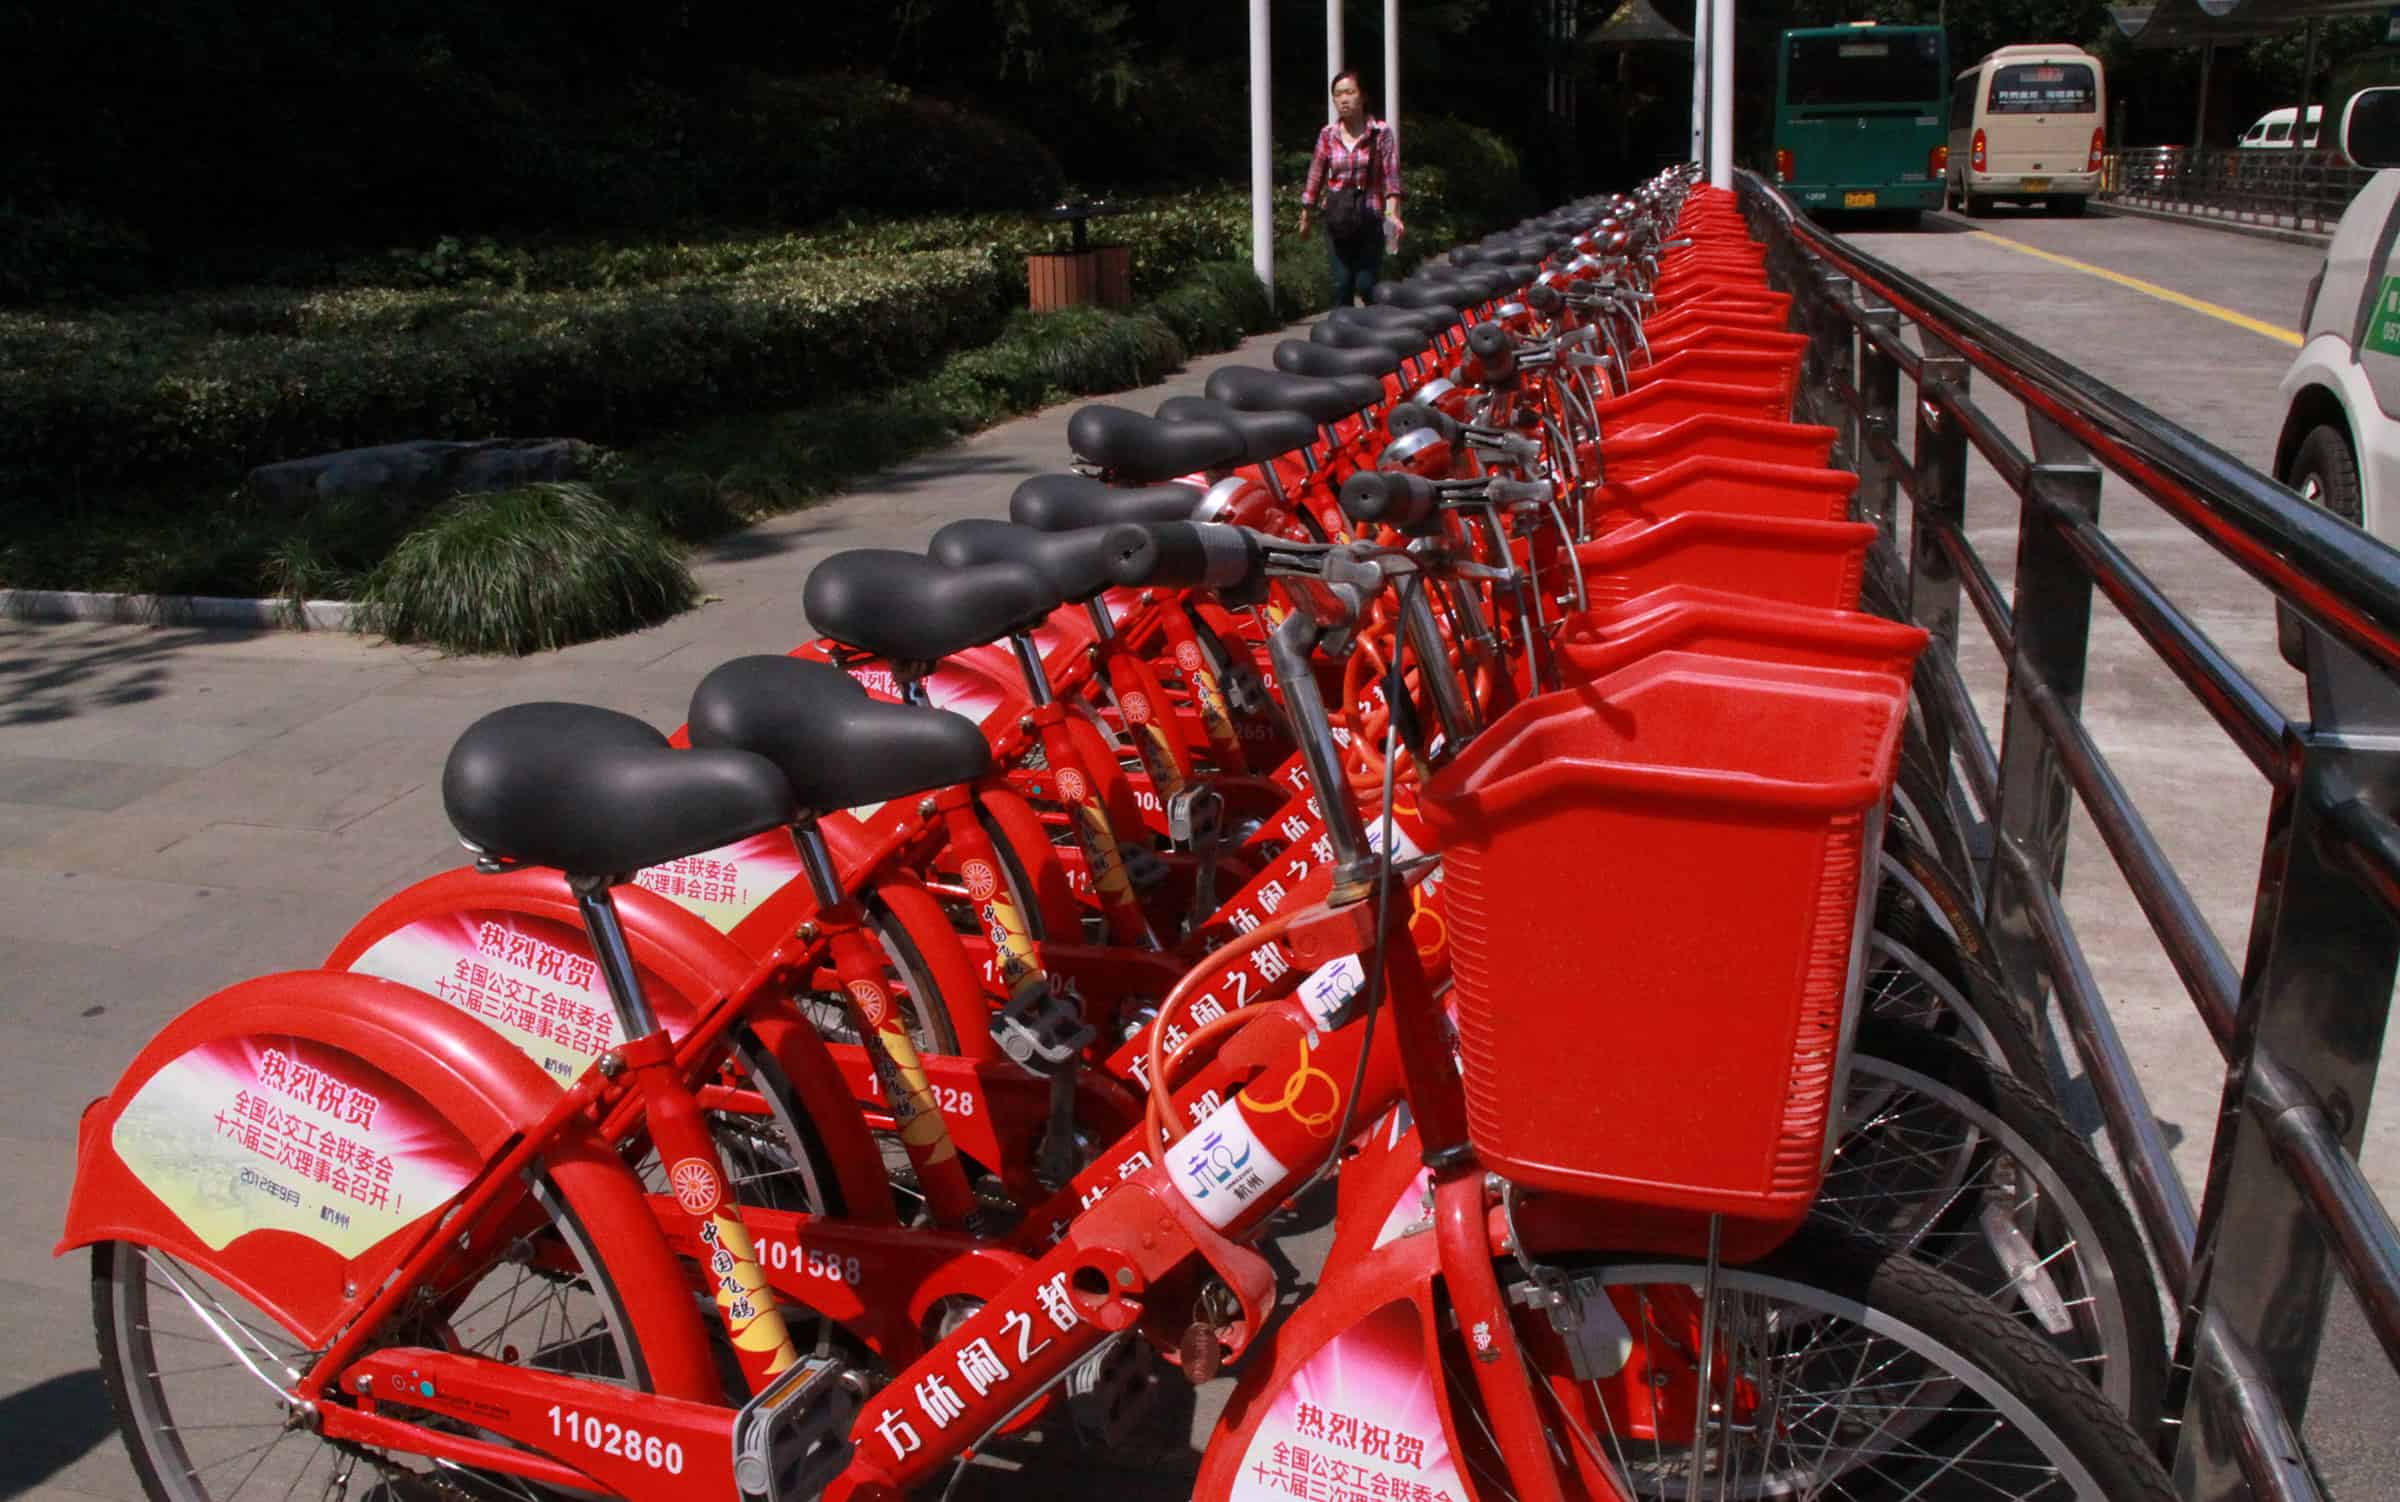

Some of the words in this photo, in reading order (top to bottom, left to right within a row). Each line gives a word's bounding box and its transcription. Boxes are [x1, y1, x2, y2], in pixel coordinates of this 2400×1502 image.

[480, 921, 598, 992] 热烈祝贺
[453, 957, 614, 1037] 全国公交工会联委会
[259, 1049, 379, 1132] 热烈祝贺
[214, 1109, 403, 1215] 十六届三次理事会召开！
[232, 1089, 395, 1184] 全国公交工会联委会
[1234, 1172, 1265, 1200] 杭州
[547, 1404, 683, 1474] 1102860
[1296, 1401, 1425, 1470] 热烈祝贺
[1252, 1461, 1385, 1502] 十六届三次
